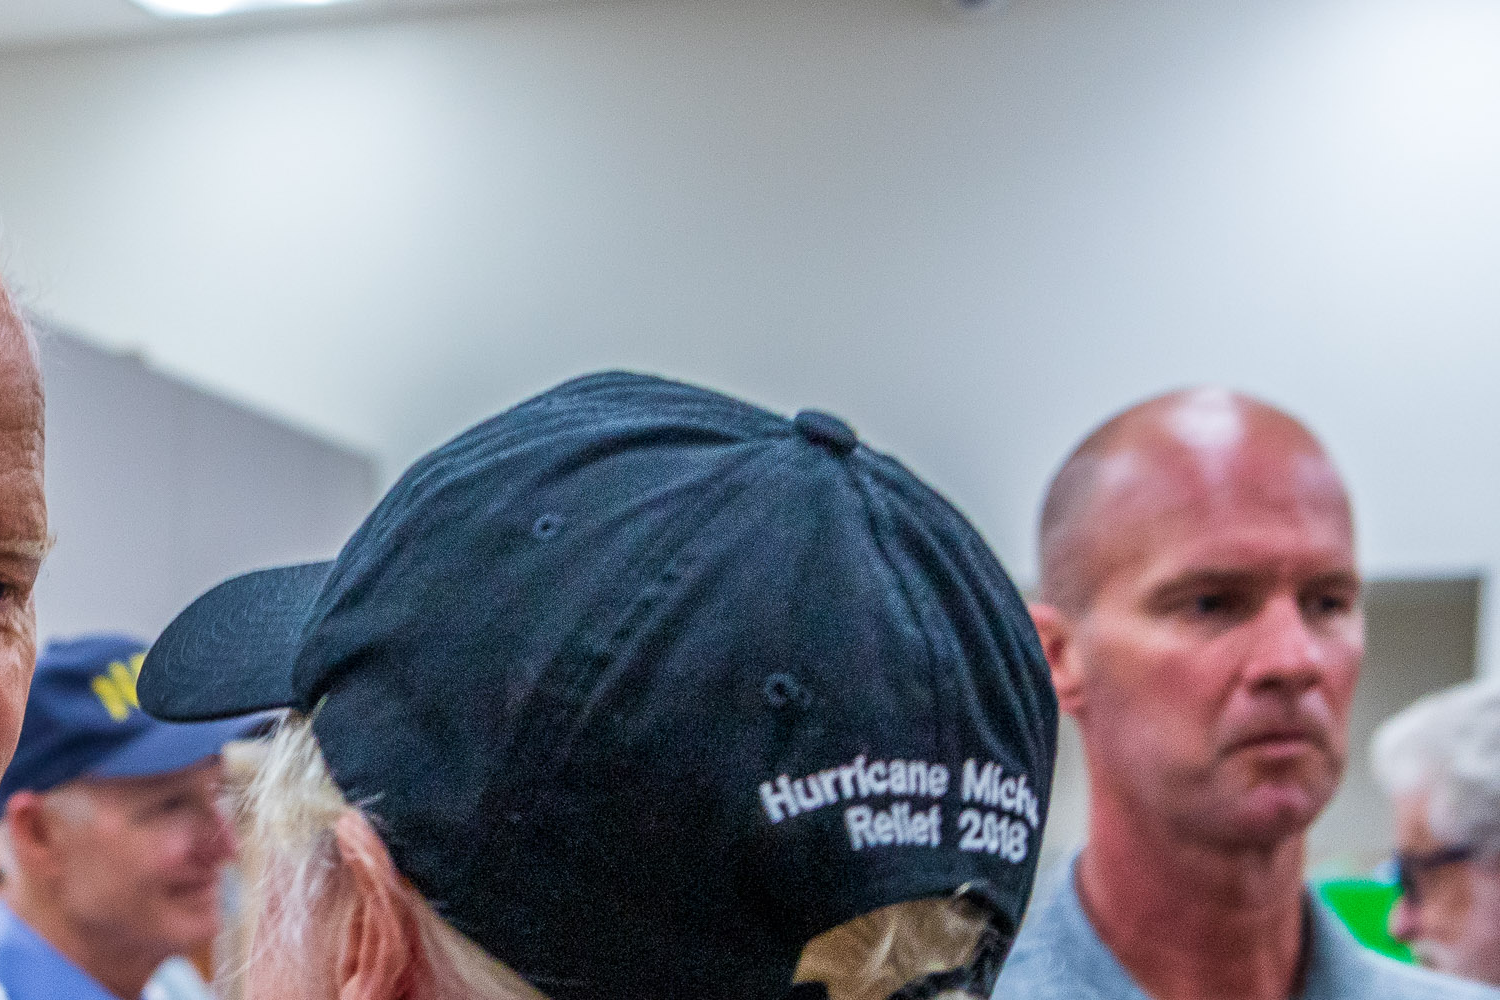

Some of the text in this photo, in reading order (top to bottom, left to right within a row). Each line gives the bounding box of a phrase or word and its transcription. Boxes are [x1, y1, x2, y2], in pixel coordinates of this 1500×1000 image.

[758, 754, 949, 824] Hurricane
[845, 801, 1029, 864] Relief 2018
